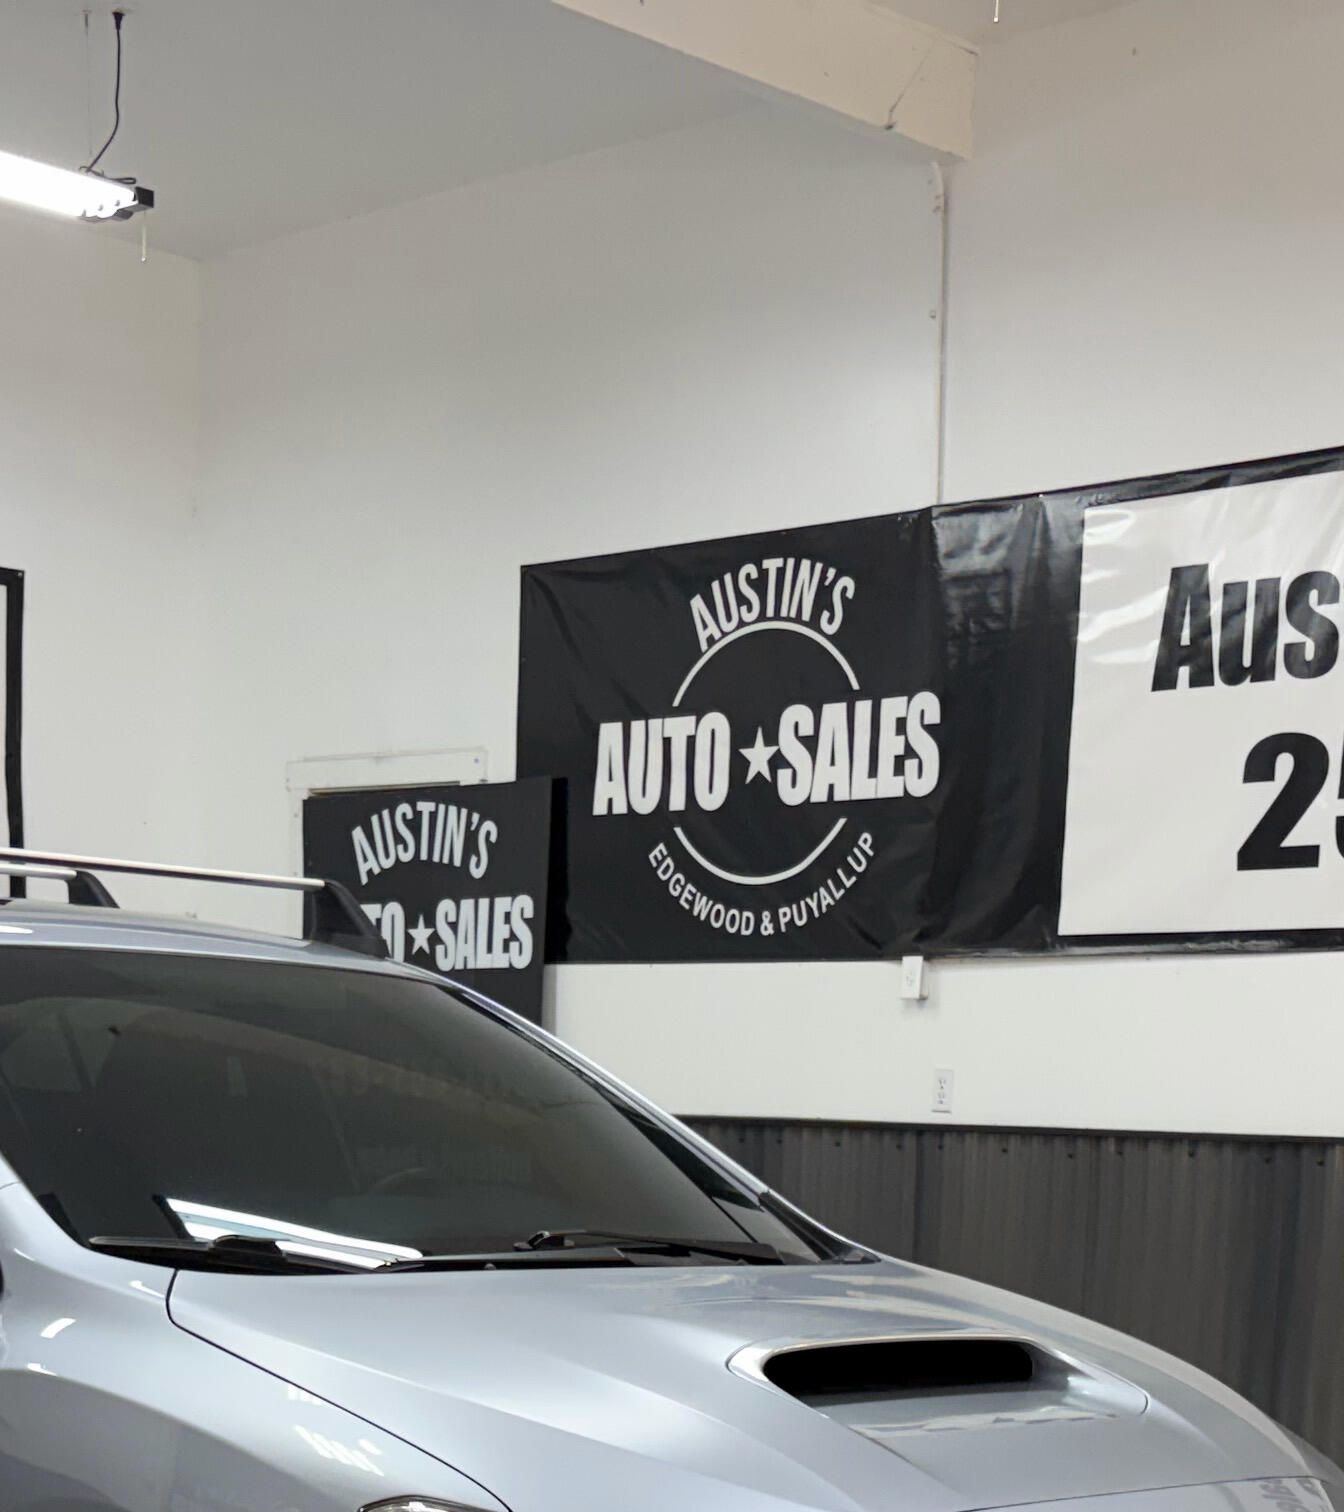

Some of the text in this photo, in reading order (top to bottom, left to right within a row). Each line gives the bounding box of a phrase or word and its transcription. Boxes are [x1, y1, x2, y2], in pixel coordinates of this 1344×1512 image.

[689, 556, 855, 653] AUSTIN'S
[592, 690, 941, 816] AUTO SALES
[351, 801, 498, 886] AUSTIN'S
[648, 831, 875, 936] EDGEWOOD & PUYALLUP
[435, 894, 534, 973] SALES
